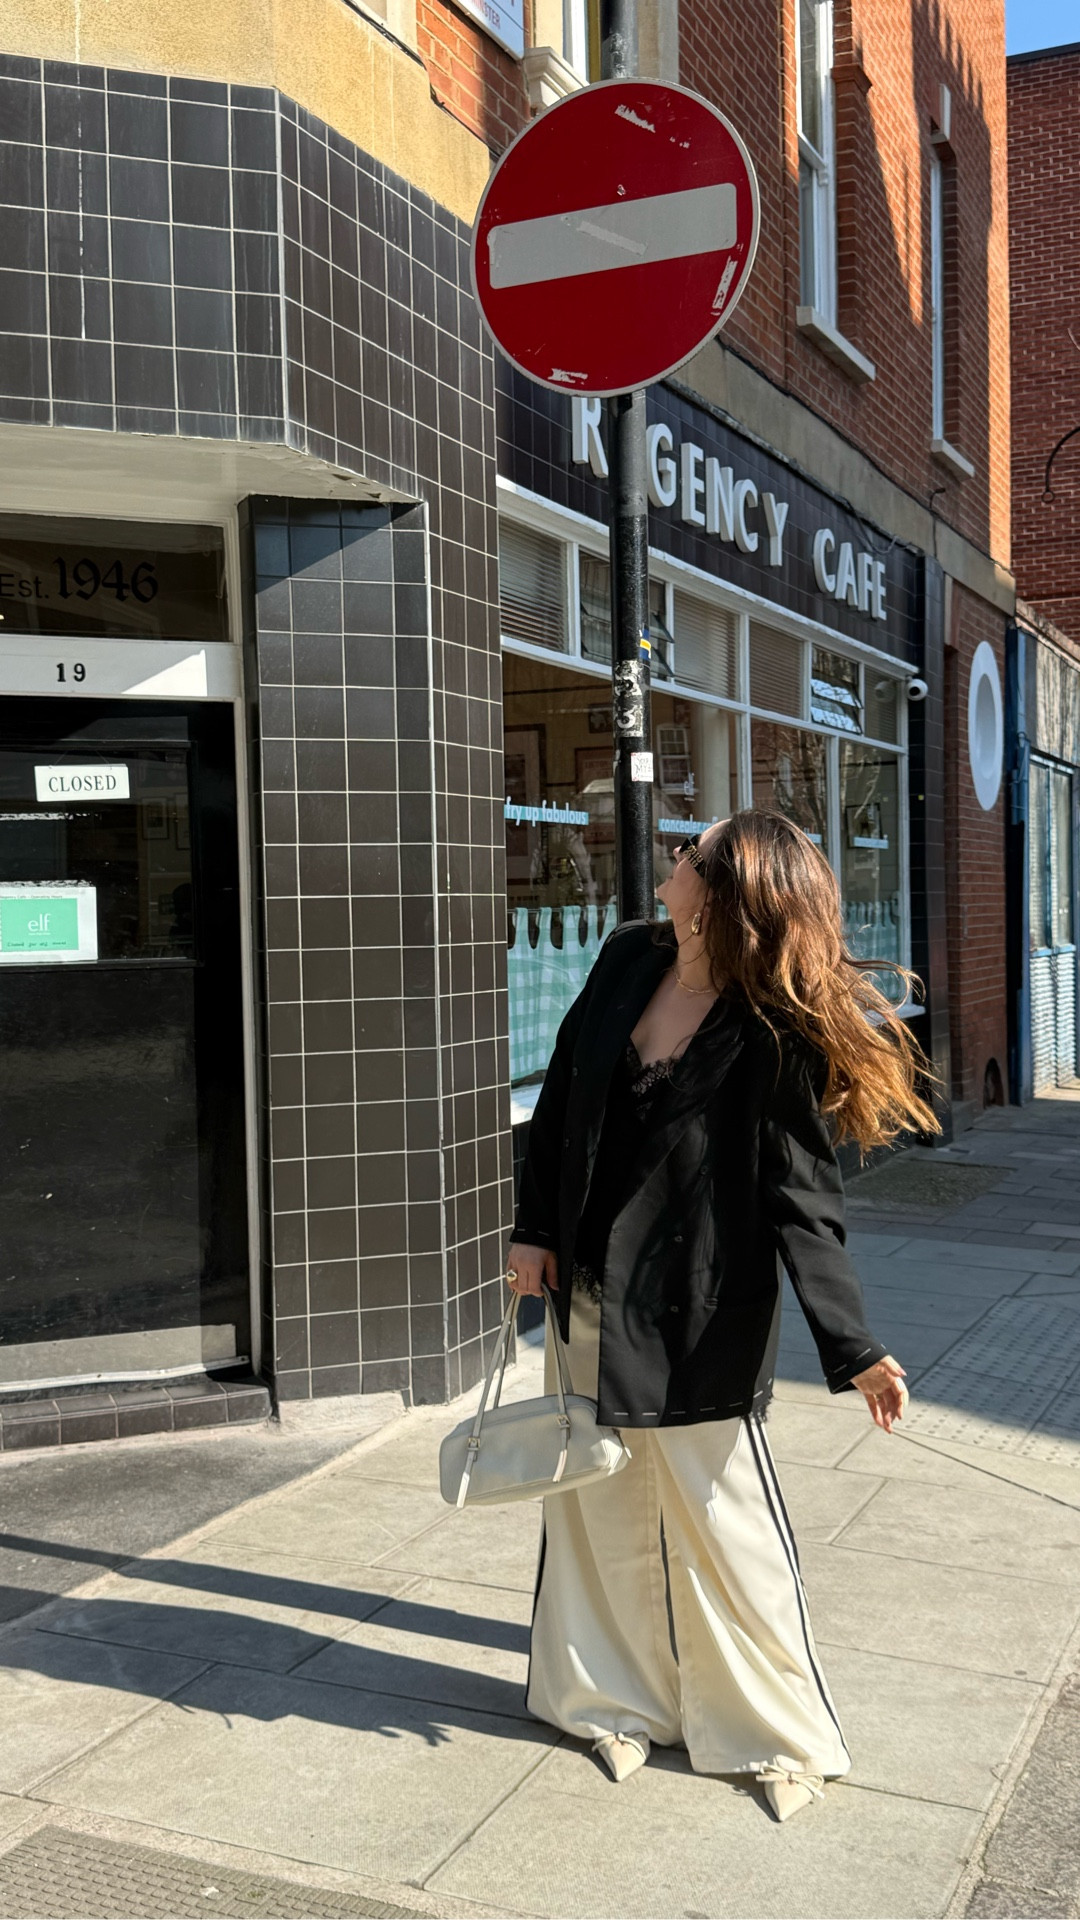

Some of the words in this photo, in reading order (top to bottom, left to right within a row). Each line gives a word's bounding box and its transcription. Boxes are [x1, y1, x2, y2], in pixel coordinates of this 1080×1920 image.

[571, 397, 789, 566] RGENCY
[813, 528, 887, 620] CAFE
[0, 573, 49, 599] Est.
[53, 556, 158, 603] 1946
[56, 662, 86, 682] 19
[48, 775, 117, 792] CLOSED
[506, 796, 521, 826] fry
[525, 806, 539, 827] up
[542, 799, 586, 825] fabulous
[659, 813, 700, 834] concealer
[28, 913, 51, 932] elf
